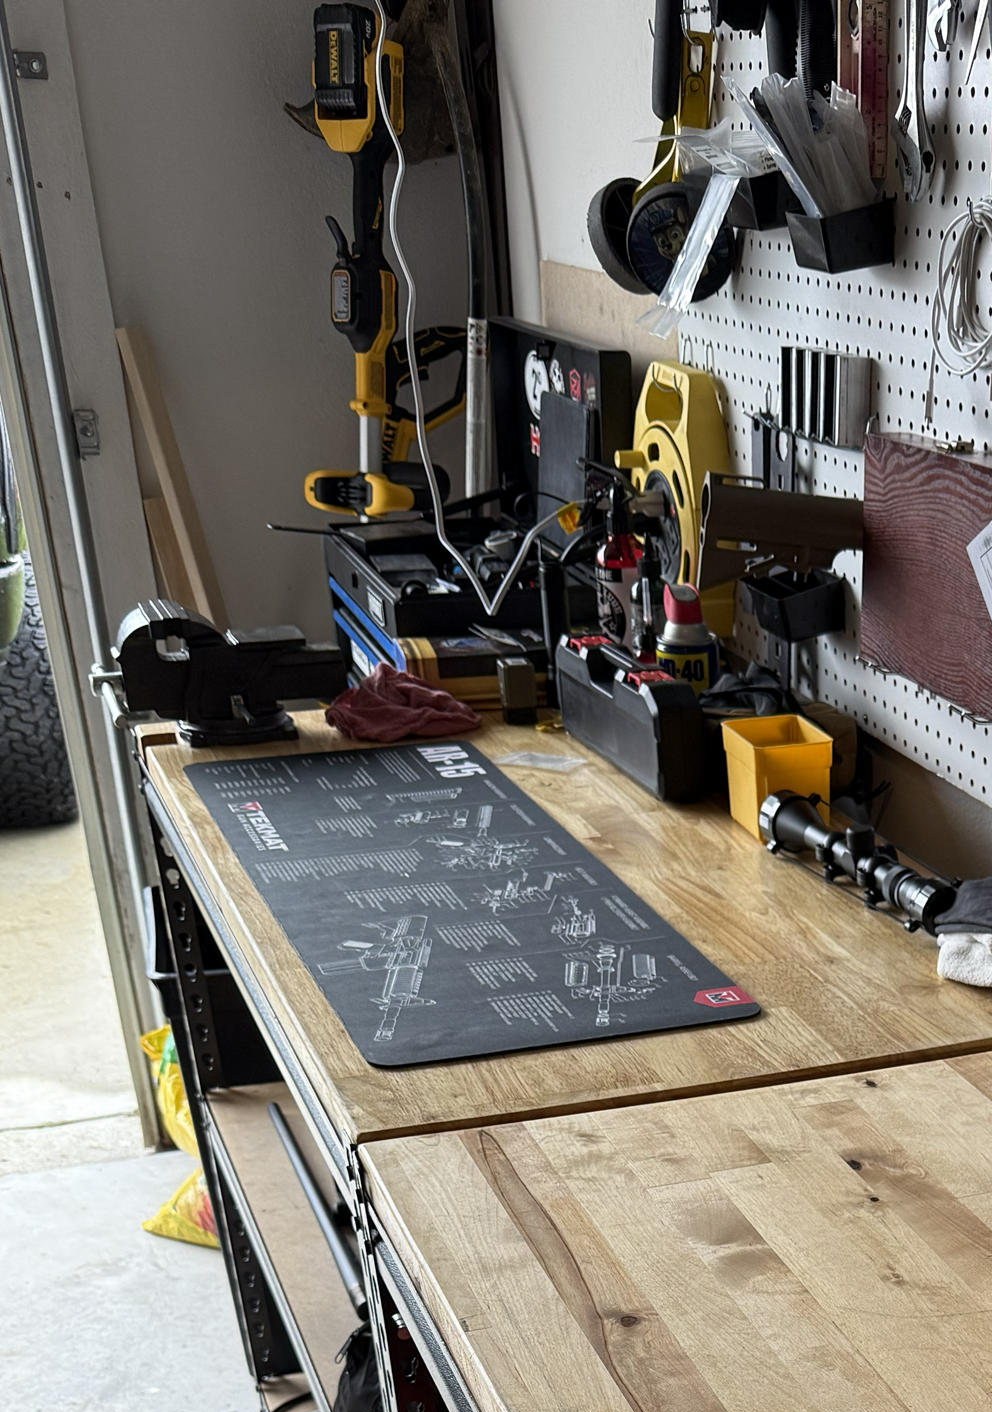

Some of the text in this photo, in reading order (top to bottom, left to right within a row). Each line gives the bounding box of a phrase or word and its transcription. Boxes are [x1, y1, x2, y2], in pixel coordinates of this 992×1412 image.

[328, 30, 339, 84] DEWALT
[416, 746, 487, 778] AR-15
[244, 810, 290, 852] TEKMAT
